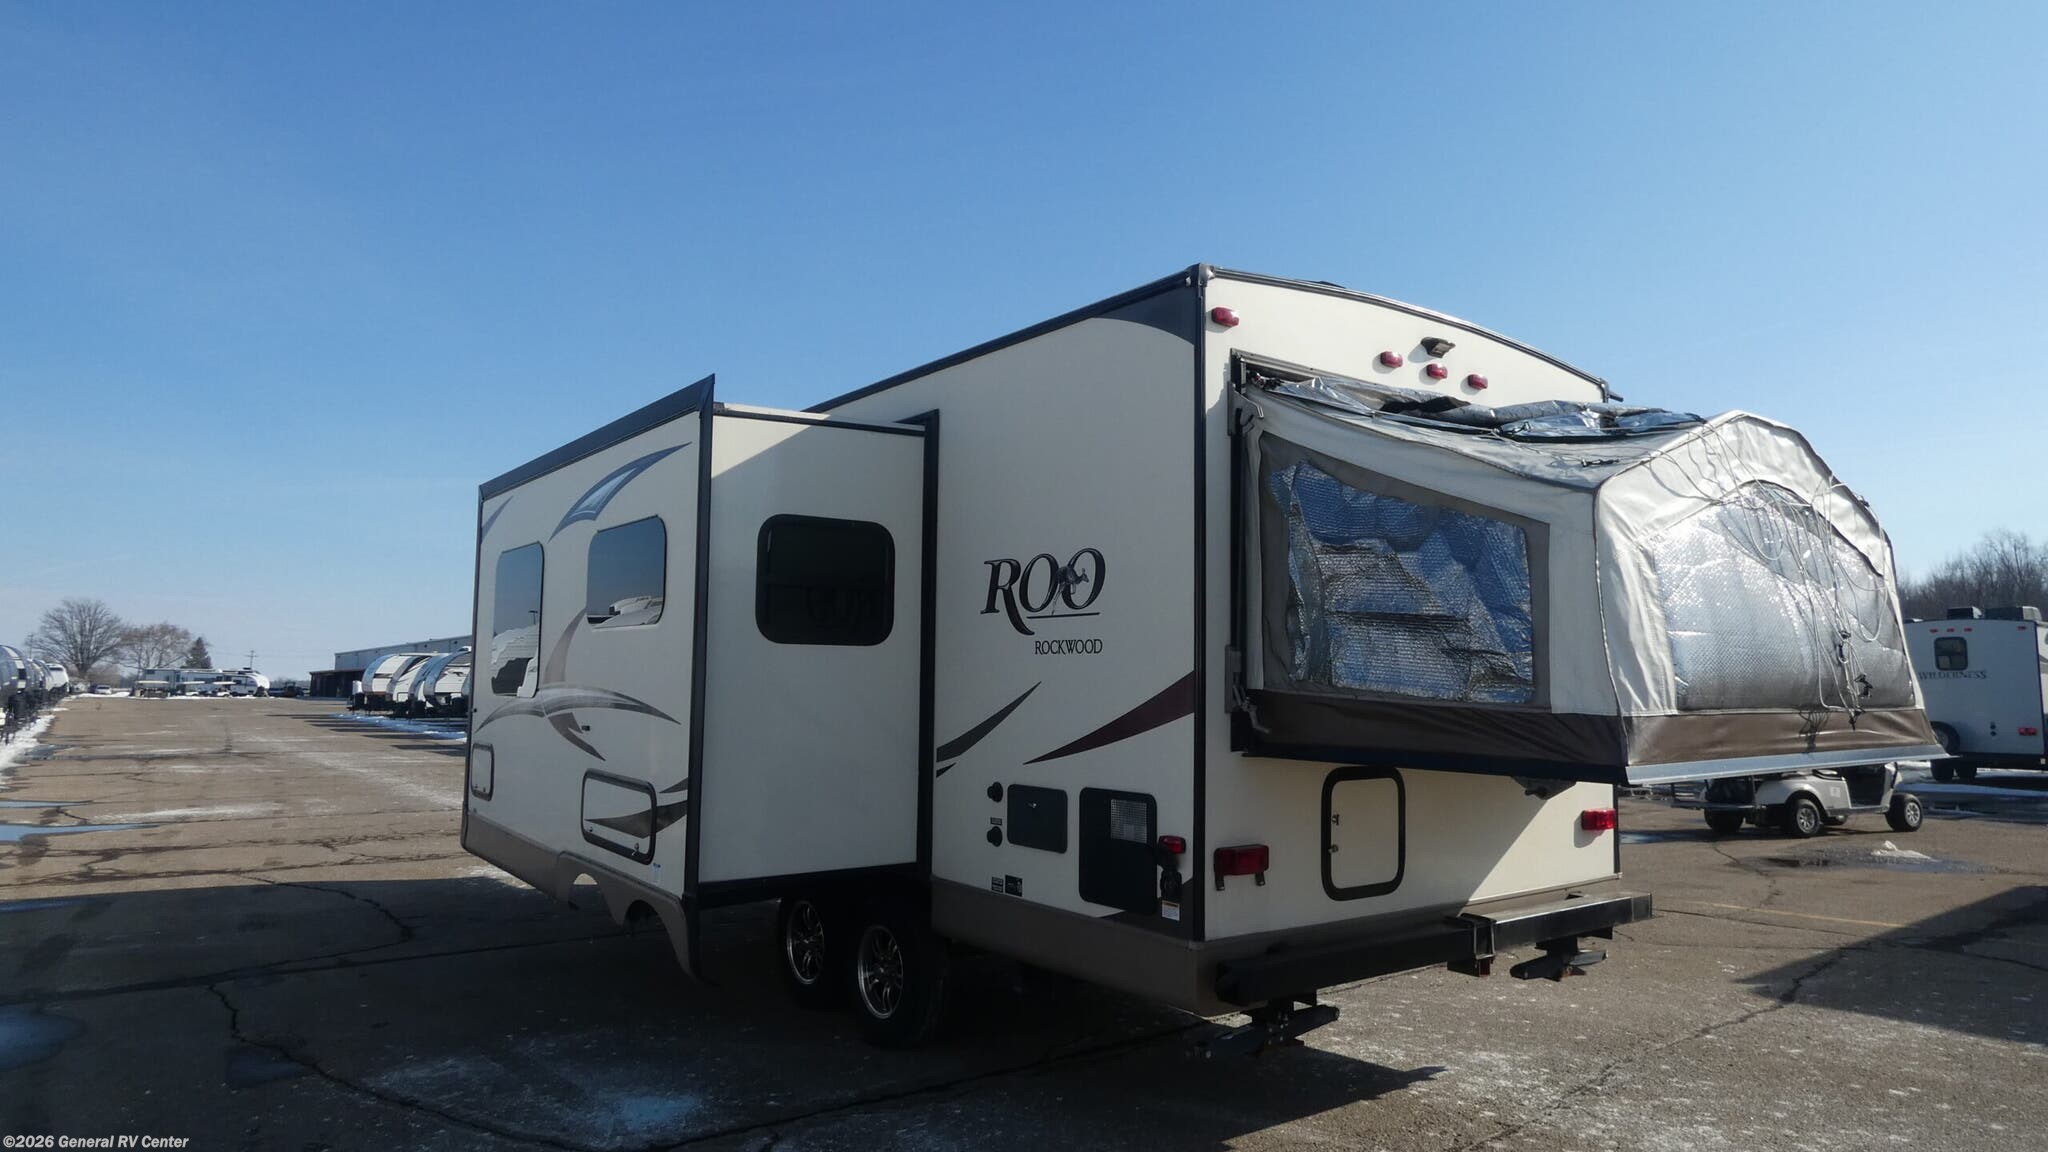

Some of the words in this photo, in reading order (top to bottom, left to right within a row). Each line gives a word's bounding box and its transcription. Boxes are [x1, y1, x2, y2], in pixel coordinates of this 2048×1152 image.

[980, 548, 1106, 635] ROO
[1035, 639, 1103, 655] ROCKWOOD
[1918, 670, 1987, 680] WILDERNESS
